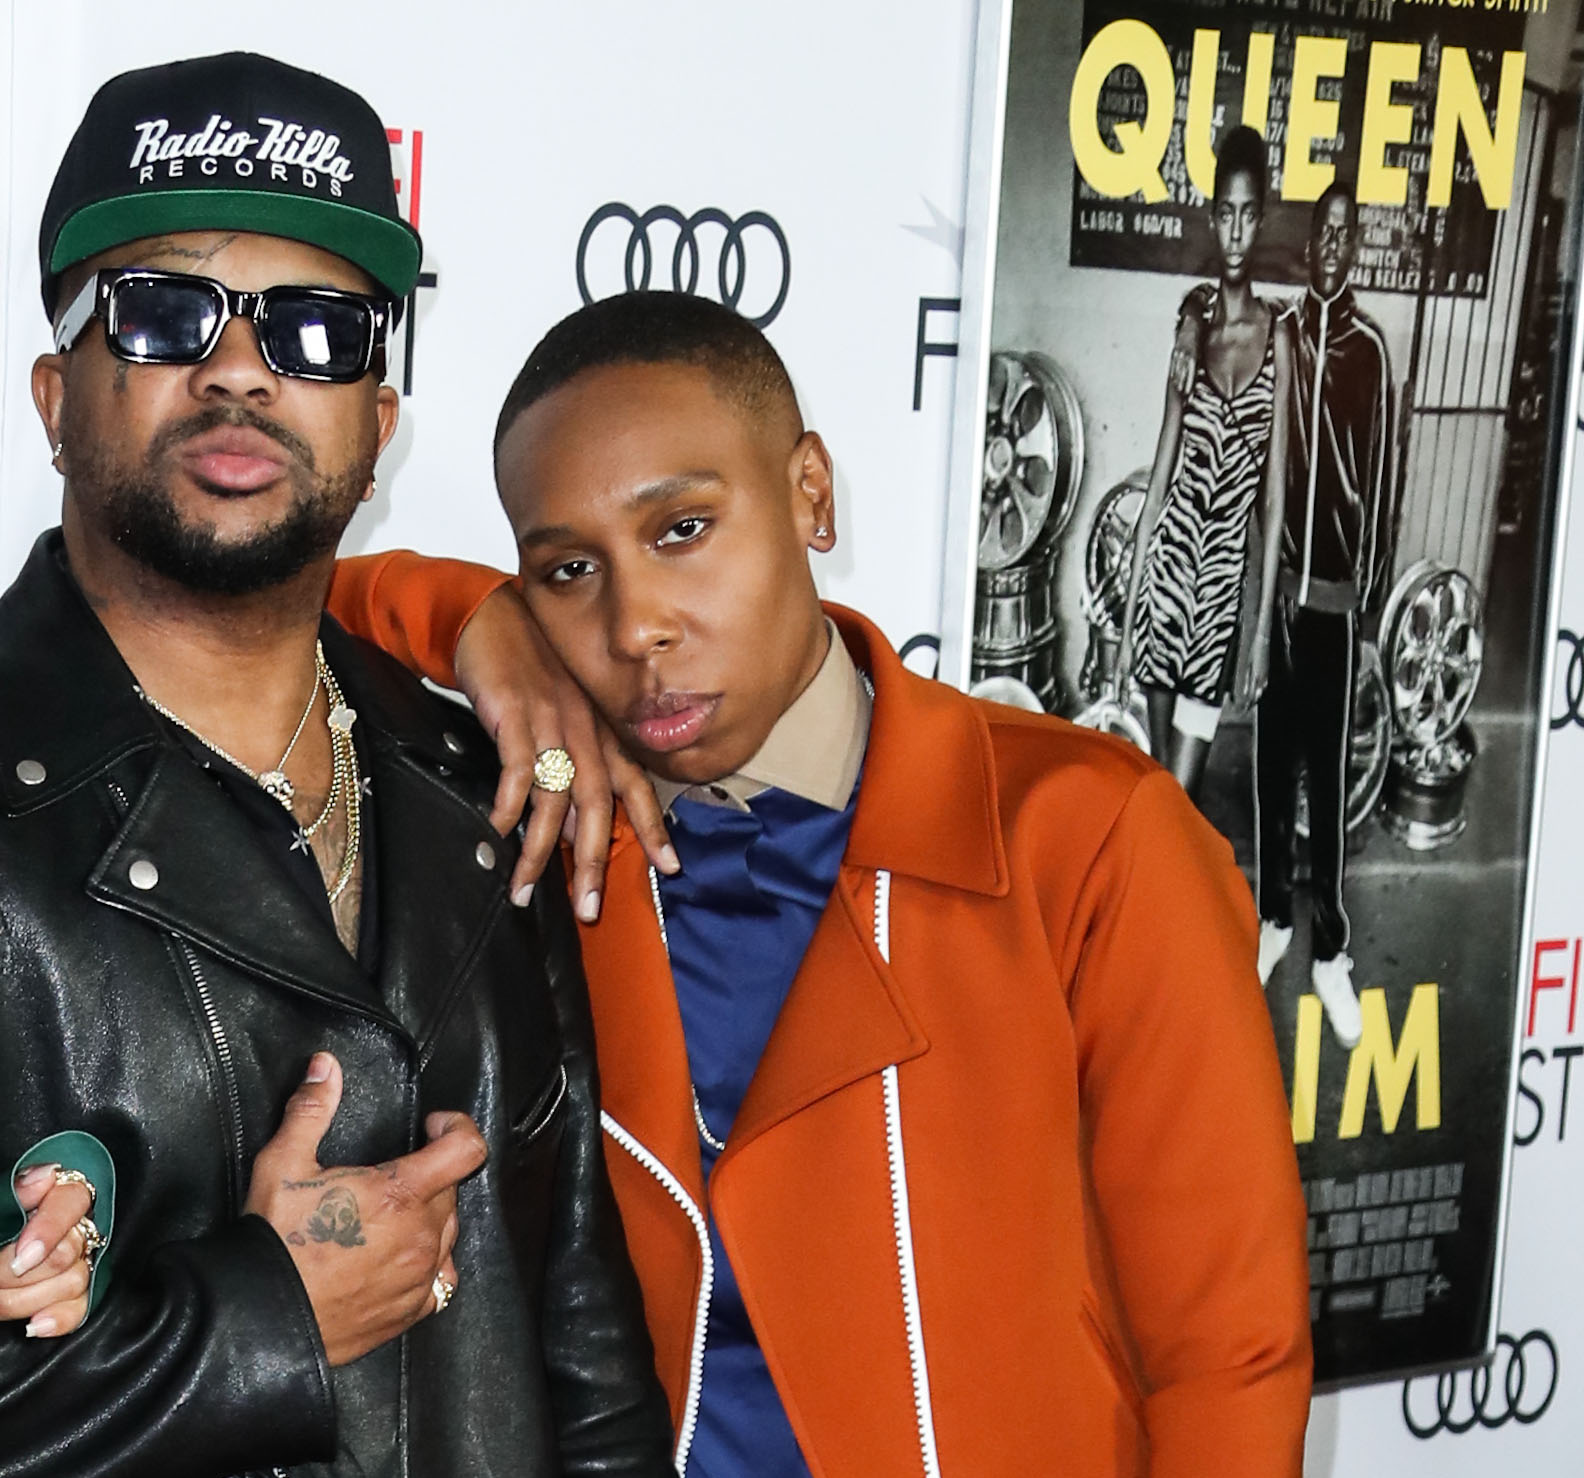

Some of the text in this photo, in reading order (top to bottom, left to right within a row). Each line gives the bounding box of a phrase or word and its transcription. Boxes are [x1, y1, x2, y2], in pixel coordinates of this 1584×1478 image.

[129, 114, 258, 169] Radio
[254, 117, 355, 184] Killa
[1069, 18, 1527, 211] QUEEN
[139, 157, 343, 198] RECORDS
[1525, 936, 1583, 1038] FI
[1291, 983, 1442, 1145] IM
[1513, 1045, 1584, 1147] ST
